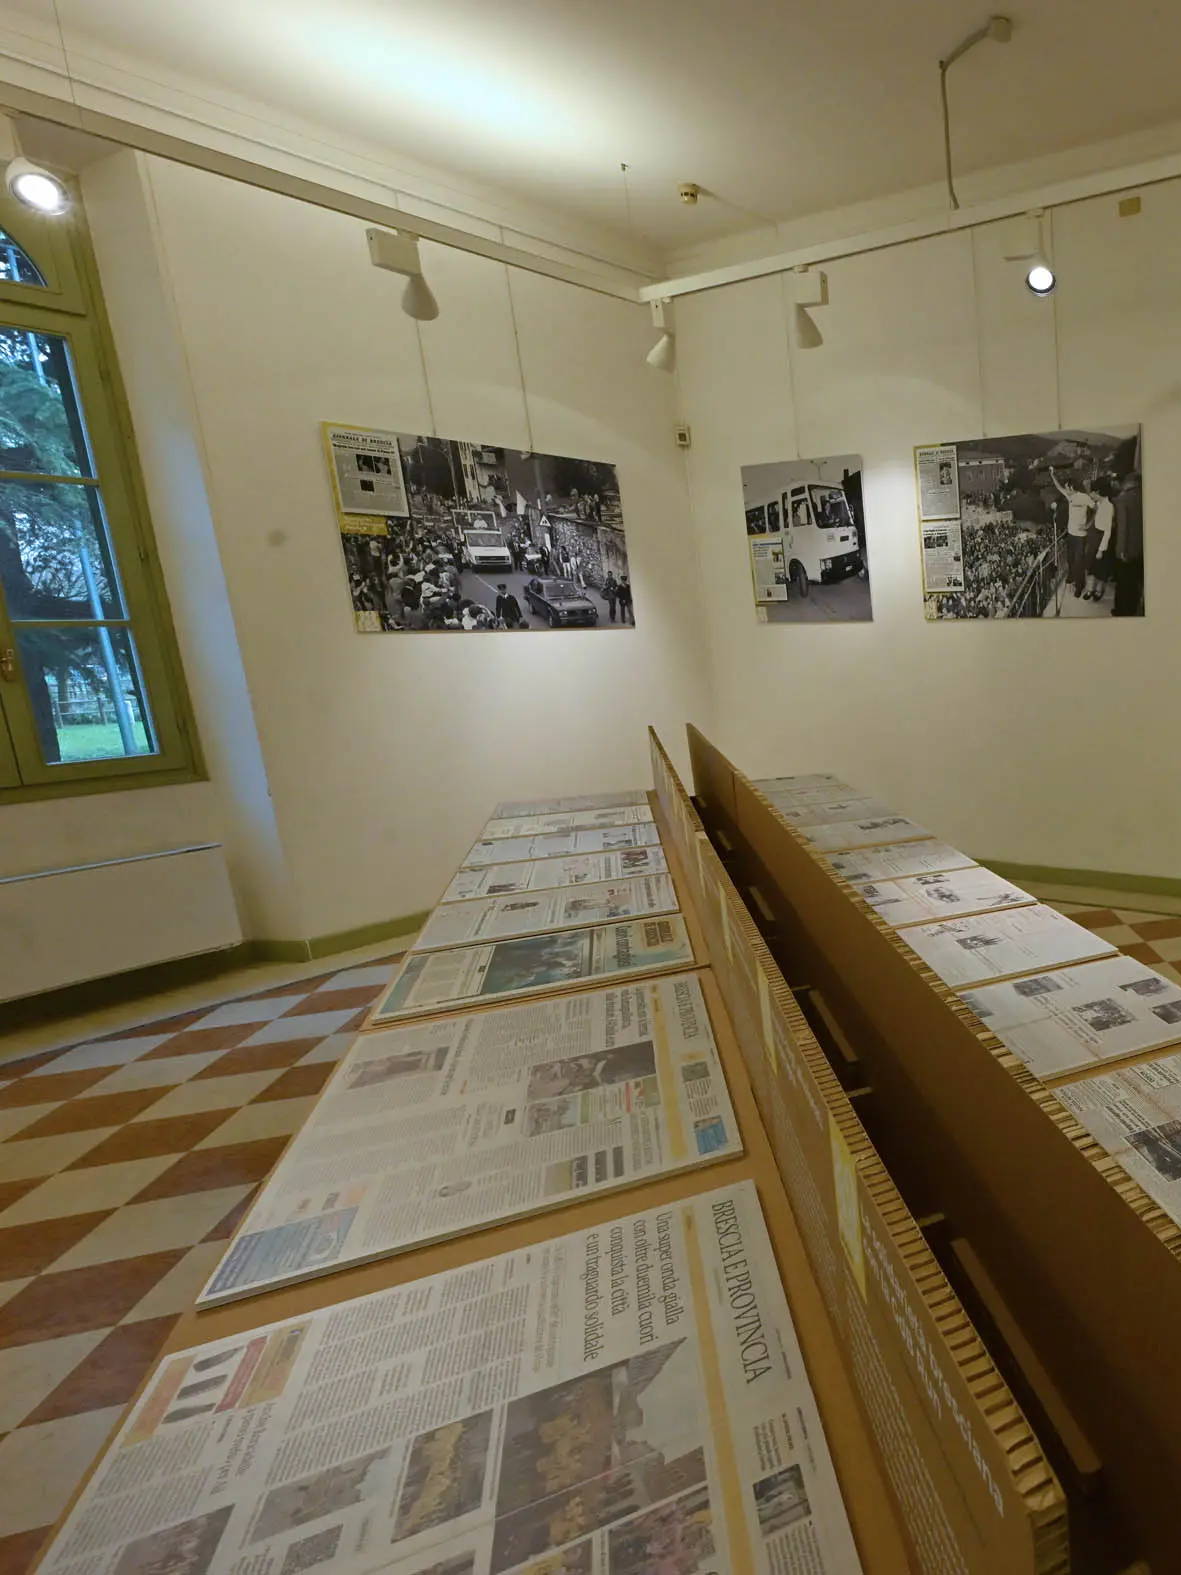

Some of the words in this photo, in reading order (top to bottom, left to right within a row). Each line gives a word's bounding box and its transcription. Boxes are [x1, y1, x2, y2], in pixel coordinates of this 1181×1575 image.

[632, 1219, 646, 1238] con
[655, 1210, 672, 1234] Una
[711, 1199, 742, 1261] BRESCIA
[585, 1240, 599, 1256] un
[604, 1226, 626, 1276] conquista
[634, 1238, 651, 1263] oltre
[649, 1233, 672, 1261] super
[581, 1255, 602, 1310] traguardo
[610, 1274, 629, 1289] la
[660, 1261, 679, 1292] onda
[723, 1258, 747, 1274] E
[610, 1288, 629, 1315] città
[635, 1263, 655, 1310] duemila
[657, 1292, 683, 1325] gialla
[583, 1311, 604, 1360] solidale
[638, 1310, 658, 1345] cuori
[726, 1271, 770, 1382] PROVINCIA
[915, 1348, 941, 1417] Run
[928, 1345, 1003, 1514] bresciana
